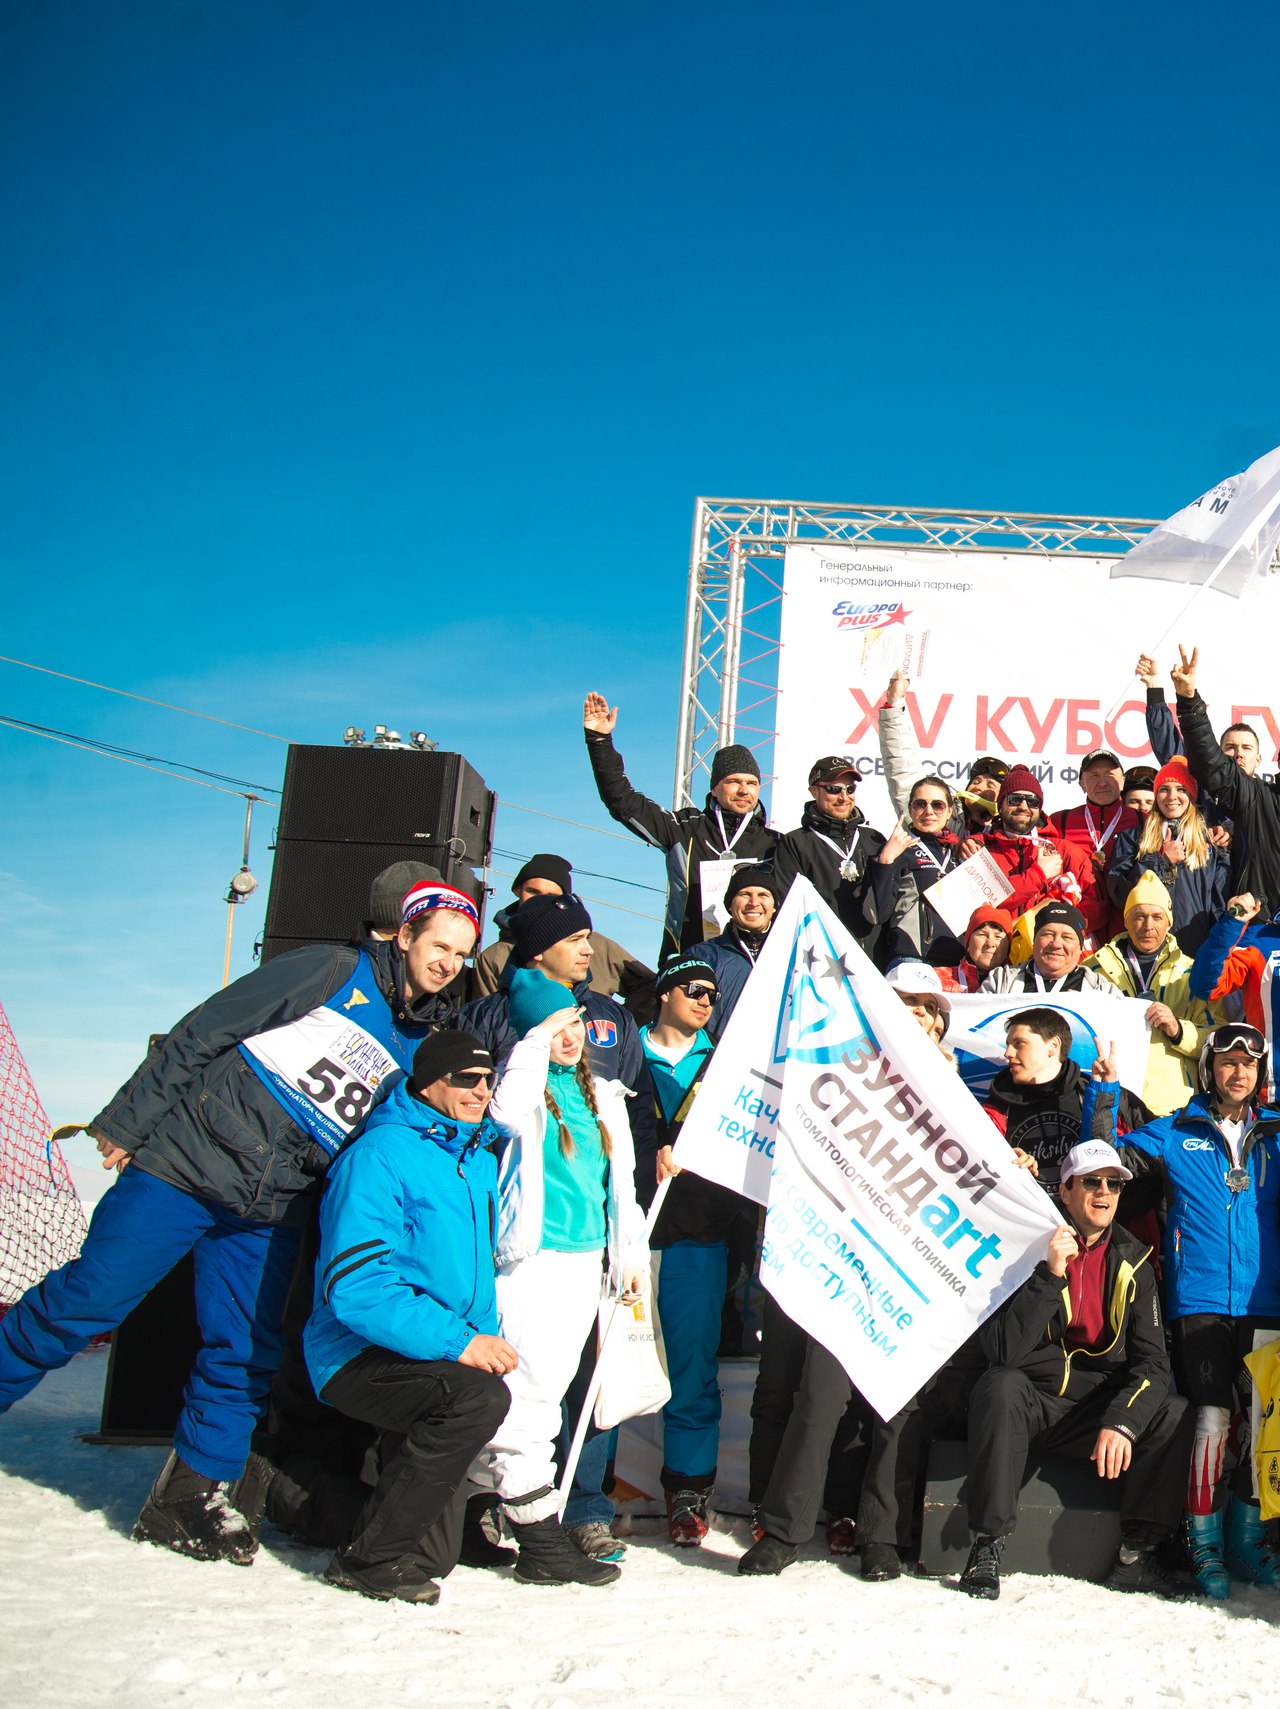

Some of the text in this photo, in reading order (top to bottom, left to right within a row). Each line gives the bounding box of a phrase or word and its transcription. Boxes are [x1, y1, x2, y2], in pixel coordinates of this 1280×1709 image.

[819, 575, 974, 592] информационный партнер:
[820, 559, 893, 573] Генеральный
[832, 601, 899, 616] Europa
[844, 687, 954, 749] XV
[975, 695, 1210, 758] КУБО
[297, 1057, 372, 1126] 58
[841, 1037, 1001, 1205] ЗУБНОЙ
[795, 1103, 967, 1297] СТОМАТОЛОГИЧЕСКАЯ КЛИНИКА
[787, 1184, 913, 1331] современные
